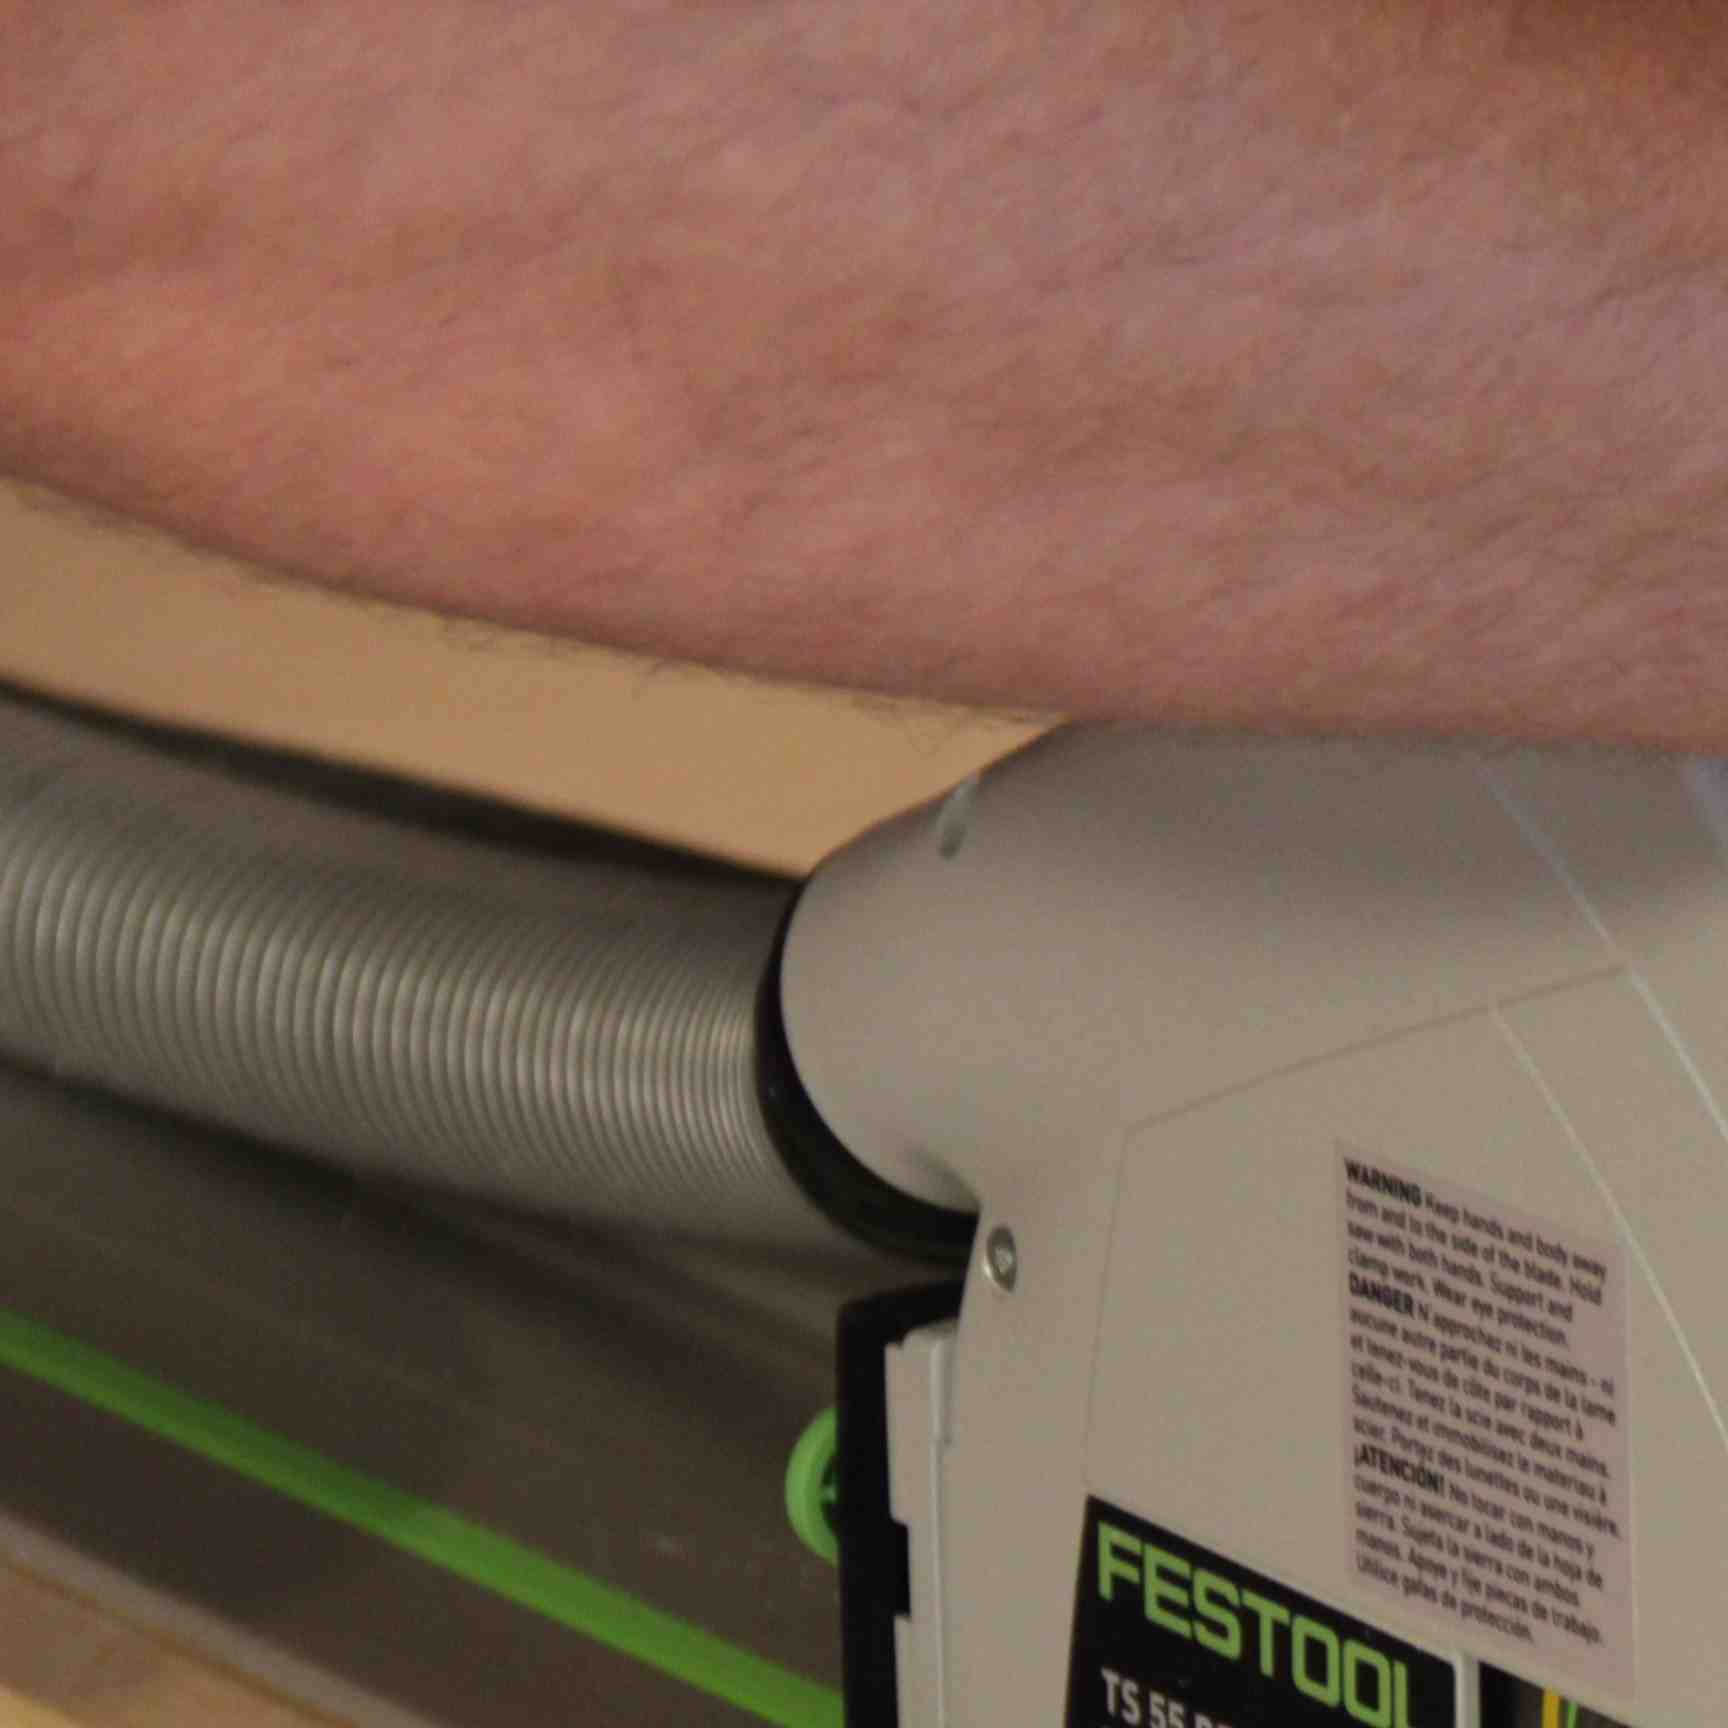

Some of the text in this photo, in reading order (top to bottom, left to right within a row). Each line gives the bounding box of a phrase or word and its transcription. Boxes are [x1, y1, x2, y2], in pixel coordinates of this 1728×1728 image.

[1345, 1160, 1422, 1206] WARNING
[1508, 1229, 1532, 1251] and
[1382, 1207, 1405, 1229] and
[1427, 1222, 1446, 1244] the
[1482, 1245, 1494, 1262] of
[1349, 1272, 1413, 1316] DANGER
[1548, 1300, 1571, 1322] and
[1101, 1667, 1141, 1726] TS
